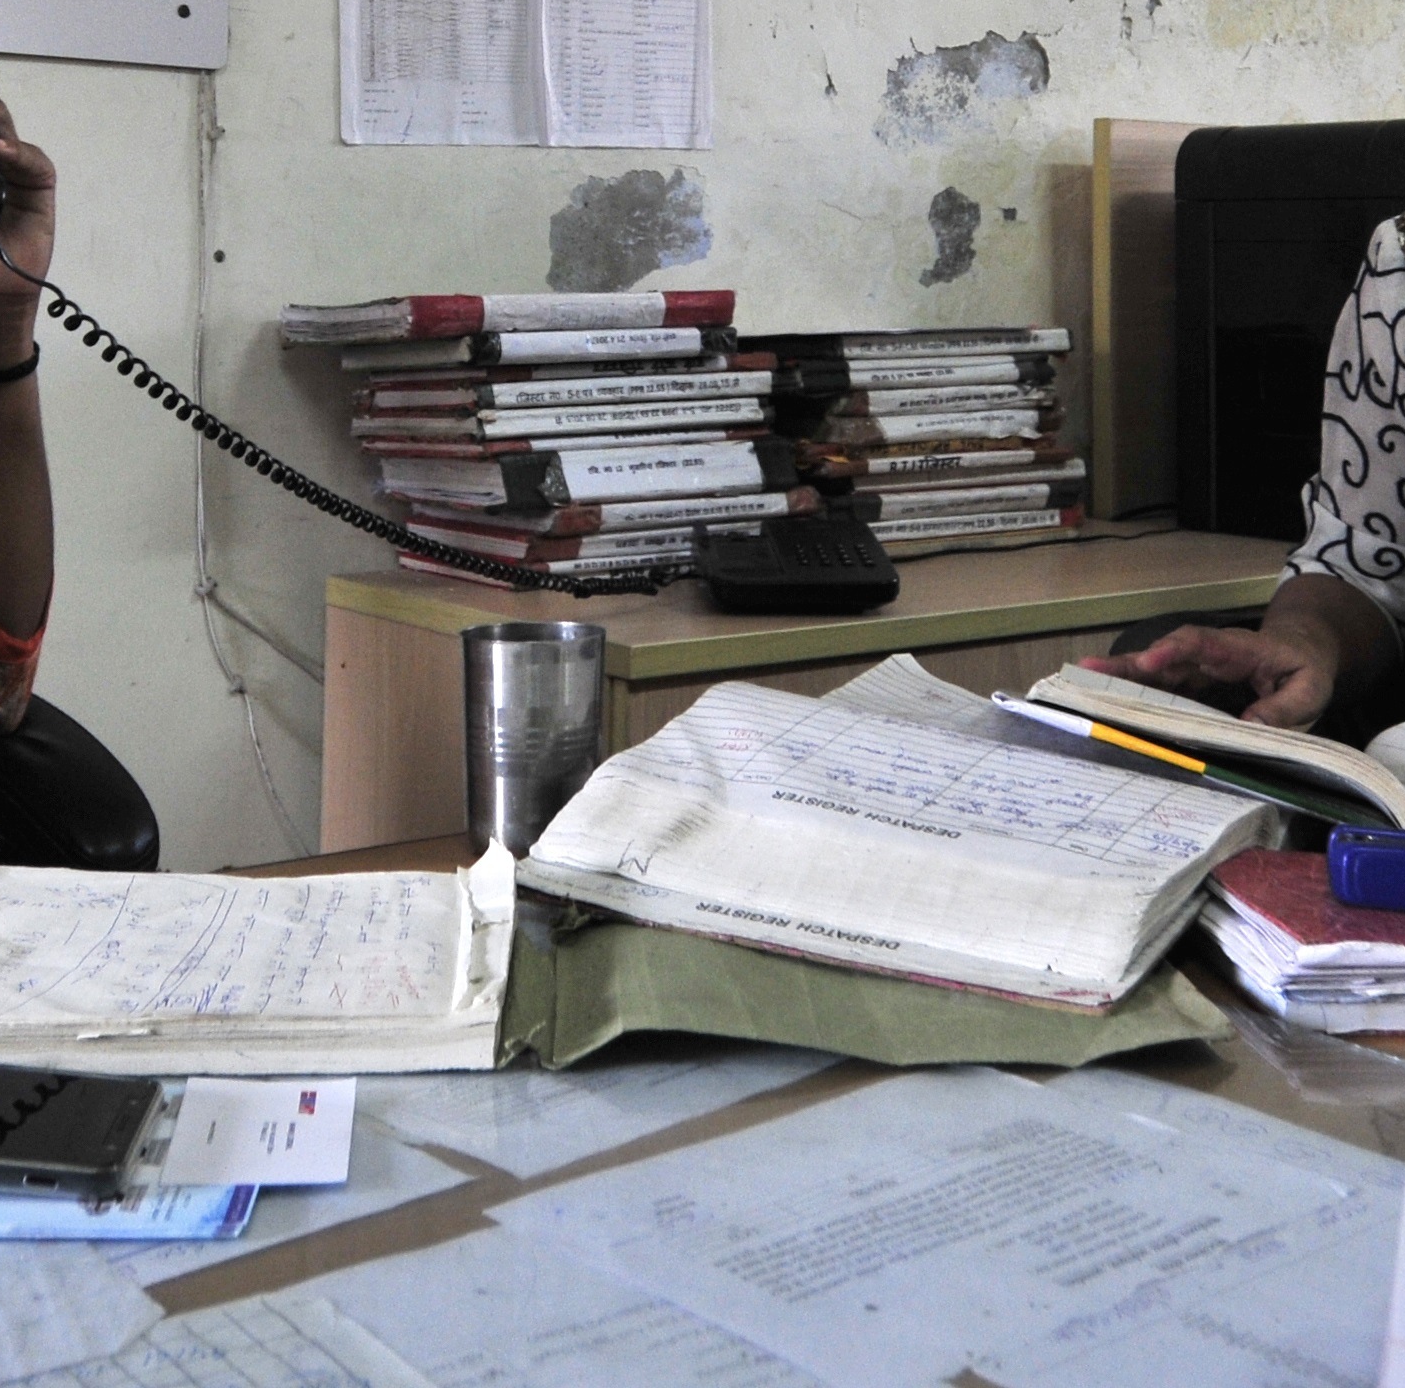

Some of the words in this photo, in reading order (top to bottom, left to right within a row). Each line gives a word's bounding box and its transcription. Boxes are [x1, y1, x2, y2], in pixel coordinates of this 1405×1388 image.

[771, 790, 860, 815] REGISTER
[865, 812, 962, 840] DESPATCH
[696, 901, 790, 928] REGISTER
[797, 921, 901, 951] DESPATCH
